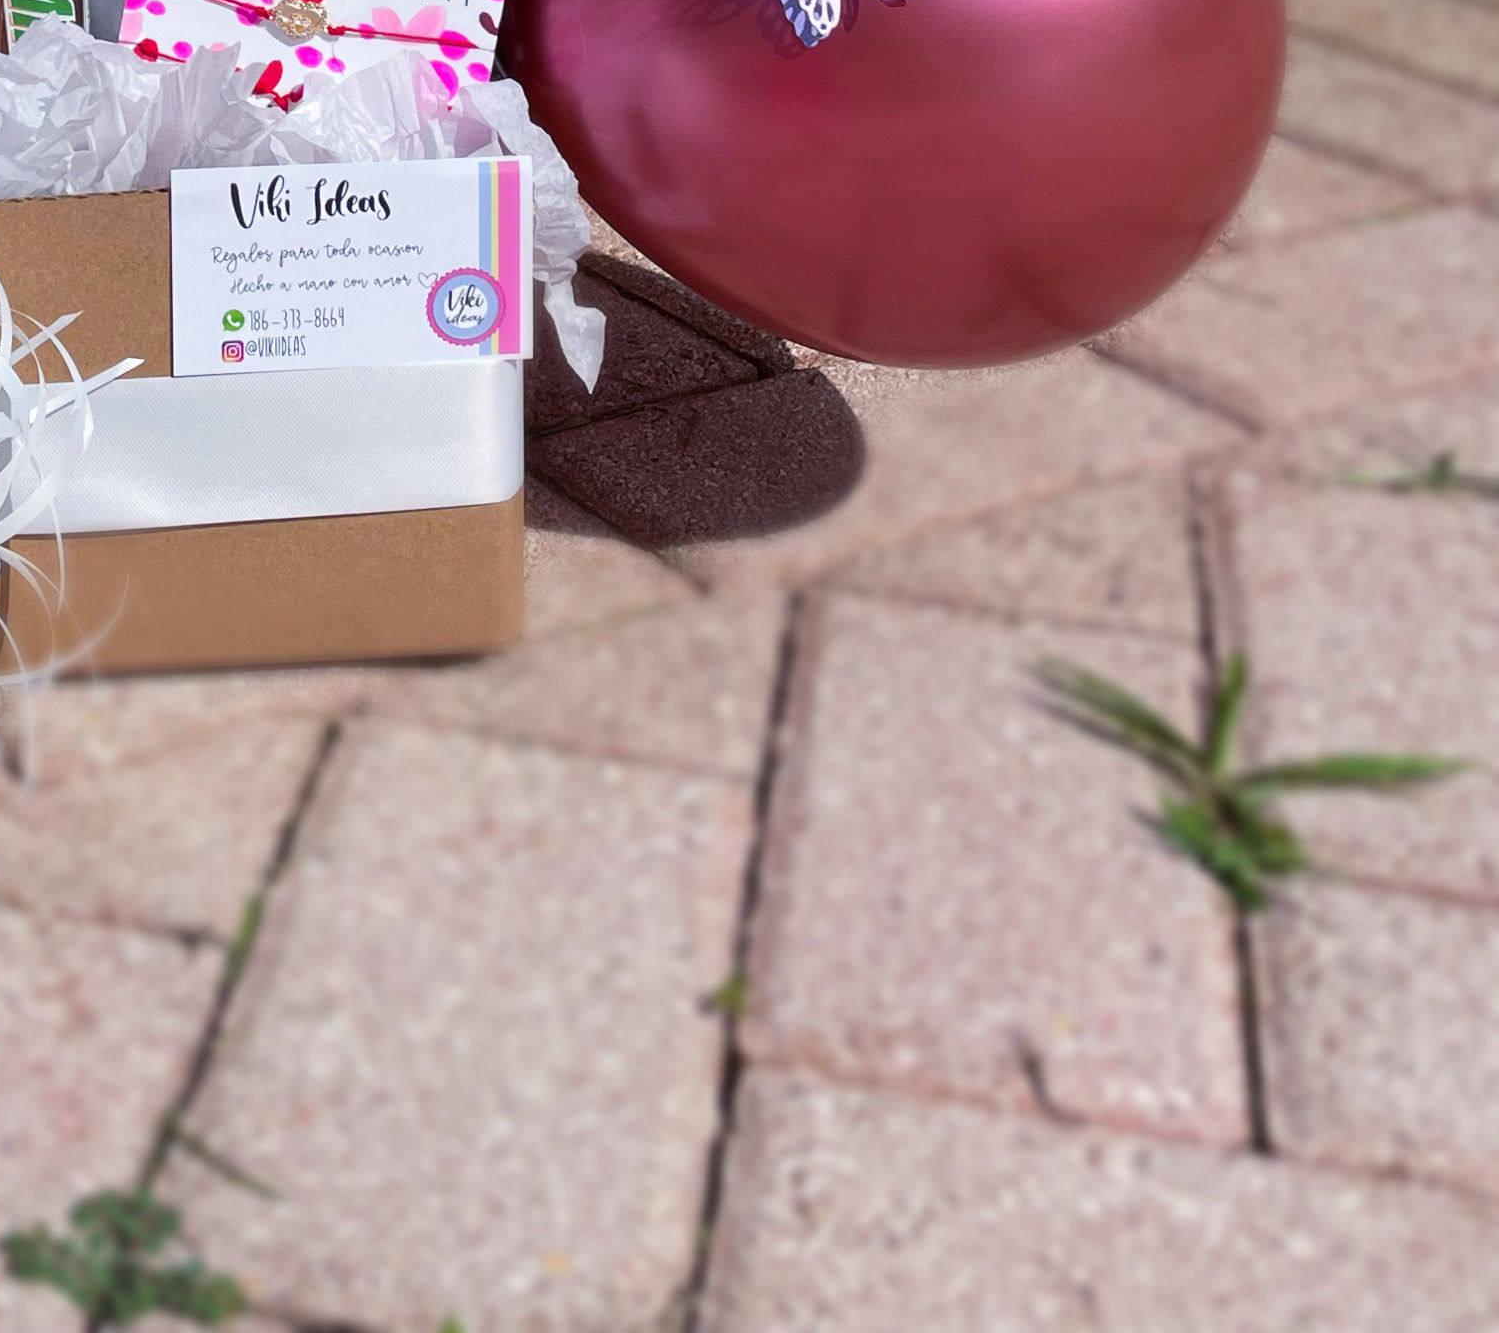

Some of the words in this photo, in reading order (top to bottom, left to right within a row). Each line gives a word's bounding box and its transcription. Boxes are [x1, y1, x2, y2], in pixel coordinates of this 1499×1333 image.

[230, 174, 291, 230] Viki
[304, 177, 392, 226] Ideas
[211, 242, 274, 274] Regalos
[279, 246, 320, 268] para
[324, 238, 362, 259] toda
[230, 273, 274, 295] Hecho
[279, 280, 292, 292] a
[298, 279, 336, 291] mano
[342, 277, 368, 289] con
[373, 274, 412, 287] amor
[448, 283, 484, 312] Viki
[245, 334, 307, 358] @VIKIIDEAS
